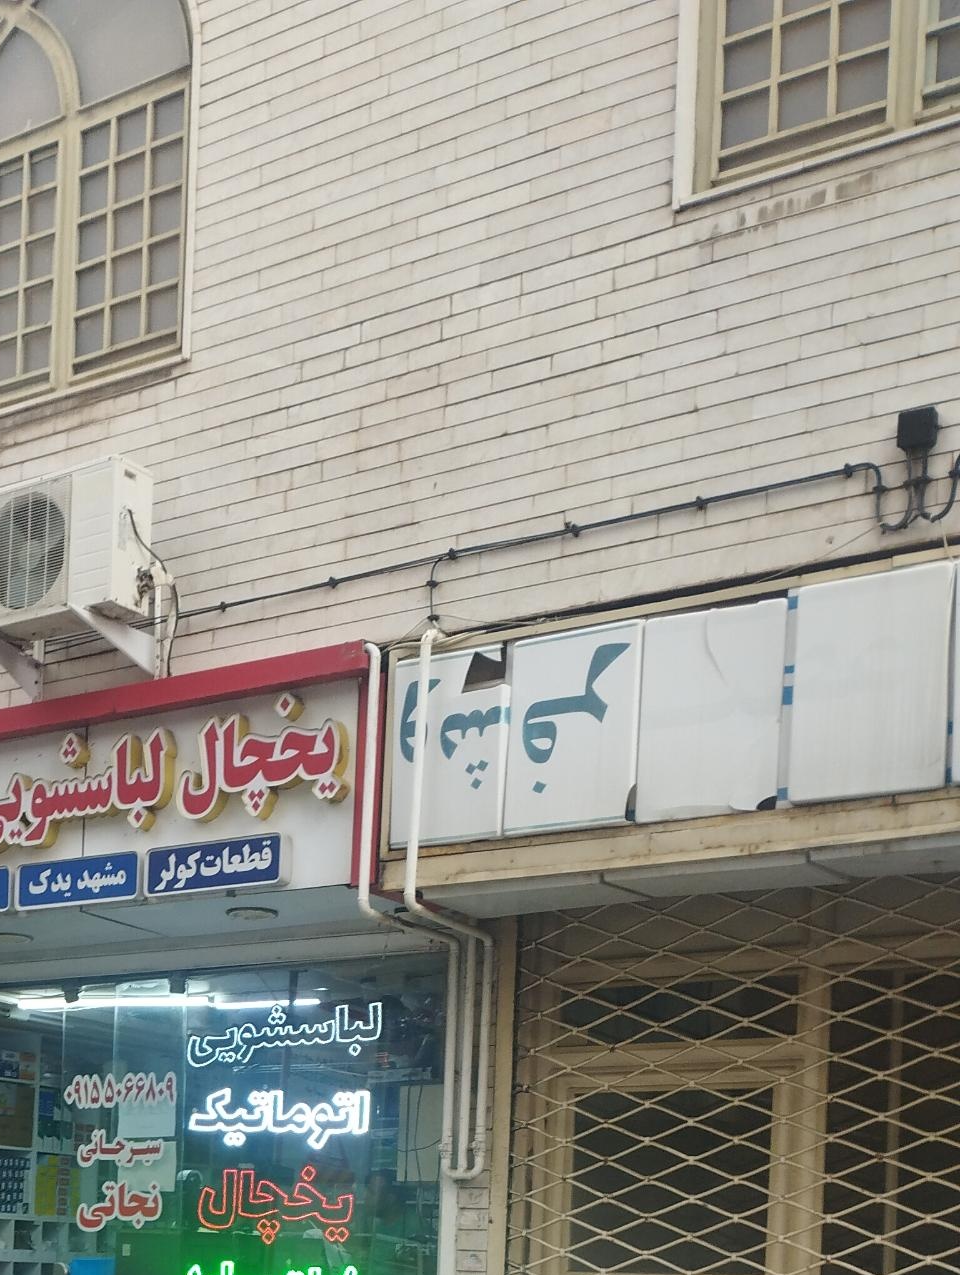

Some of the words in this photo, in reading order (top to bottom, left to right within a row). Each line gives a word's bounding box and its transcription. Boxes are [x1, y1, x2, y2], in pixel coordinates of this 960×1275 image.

[180, 692, 342, 821] یخچال
[28, 862, 72, 897] یدک
[76, 862, 127, 892] مشهد
[154, 850, 201, 890] کولر
[201, 840, 273, 877] قطعات
[187, 1002, 383, 1067] لباسشویی
[188, 1088, 371, 1150] اتوماتیک
[77, 1130, 164, 1167] سیرجانی
[77, 1181, 162, 1231] نجاتی
[198, 1165, 353, 1244] یخچال
